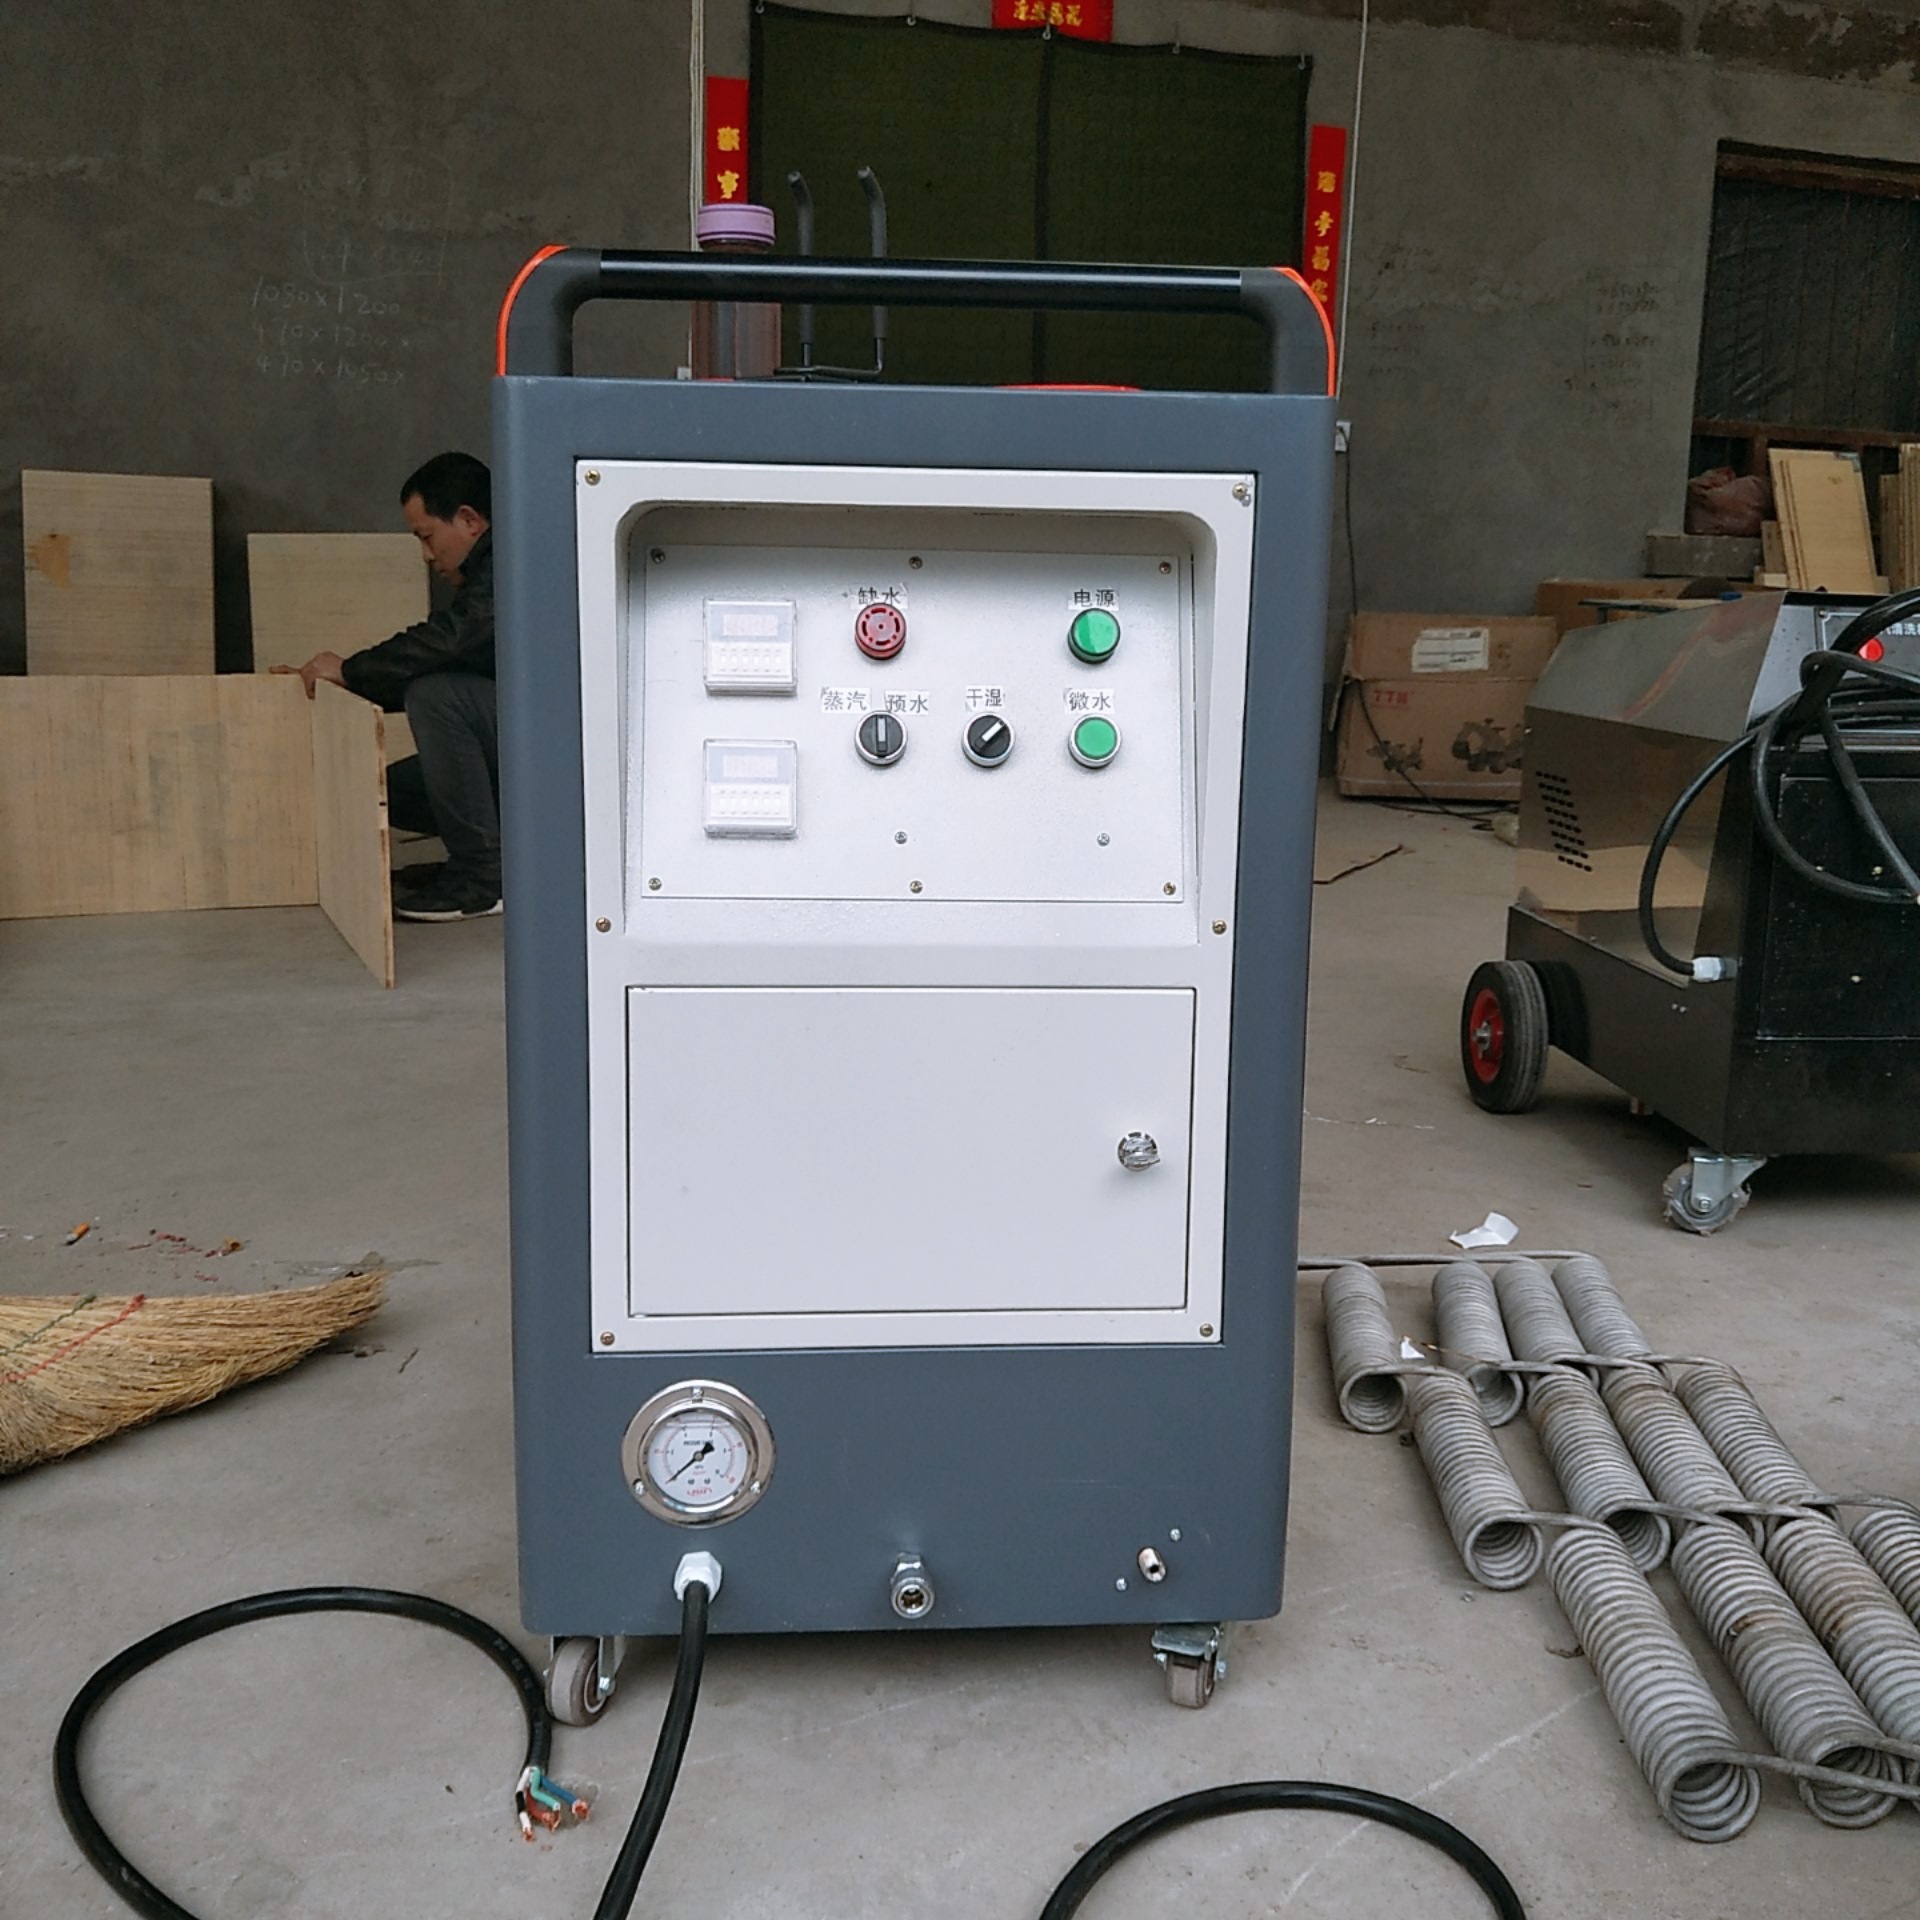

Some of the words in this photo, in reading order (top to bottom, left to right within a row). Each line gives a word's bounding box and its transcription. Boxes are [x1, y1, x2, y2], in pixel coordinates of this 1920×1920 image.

[1073, 588, 1115, 607] 电源
[823, 691, 867, 711] 蒸汽
[886, 694, 929, 713] 预水
[966, 688, 1003, 707] 干湿
[1068, 691, 1111, 711] 微水
